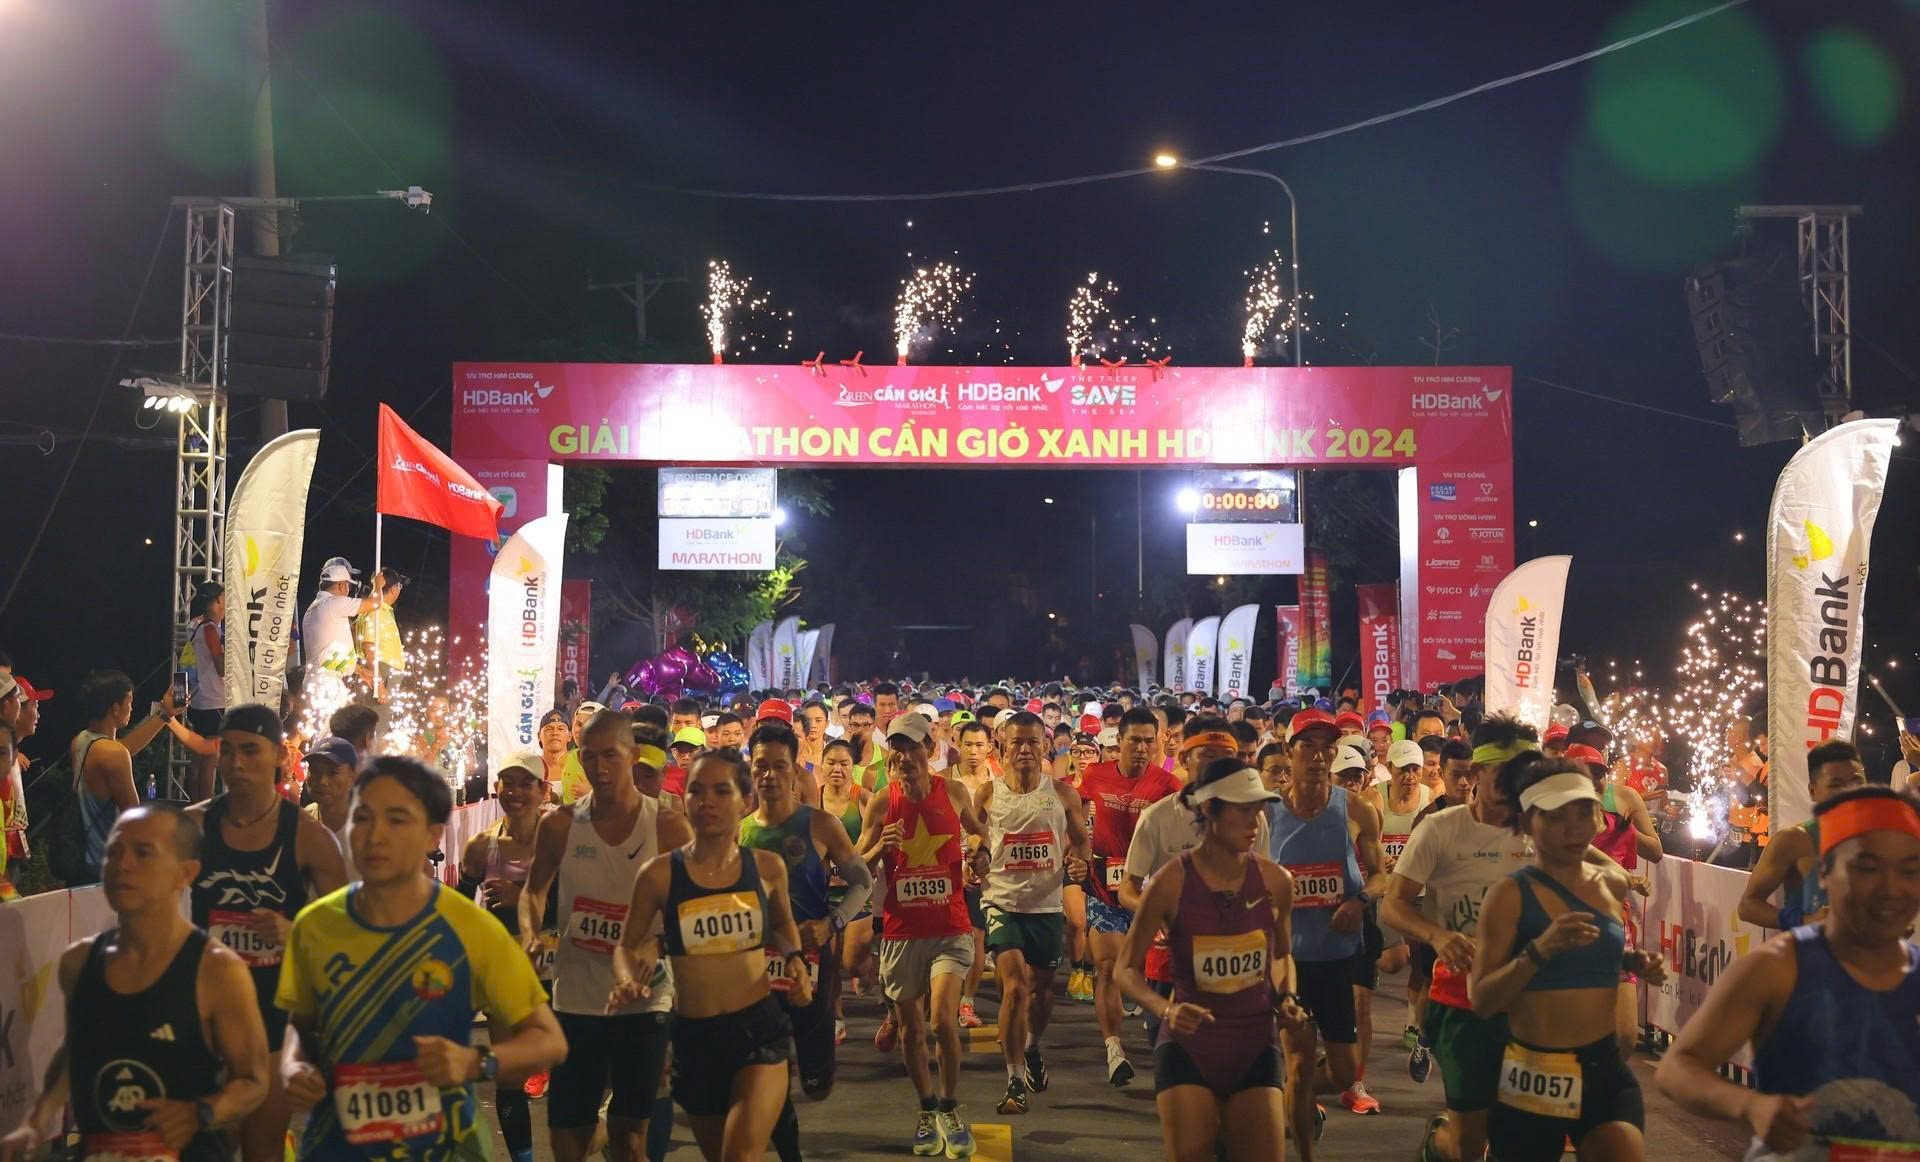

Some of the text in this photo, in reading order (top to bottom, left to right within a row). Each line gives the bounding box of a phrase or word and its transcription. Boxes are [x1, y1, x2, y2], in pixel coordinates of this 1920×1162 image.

[463, 390, 534, 405] HDBank
[958, 383, 1041, 401] HDBank
[1071, 385, 1136, 406] SAVE
[1411, 394, 1482, 409] HDBank
[640, 427, 859, 457] ATHON
[957, 421, 1030, 458] GIỜ
[1037, 429, 1145, 458] XANH
[1158, 429, 1317, 458] HDNK
[1325, 429, 1417, 458] 2024
[686, 529, 734, 540] HDBank
[1214, 535, 1263, 546] HDBank
[672, 552, 762, 565] MARATHON
[275, 575, 291, 609] nhất
[522, 575, 539, 646] HDBank
[269, 616, 282, 642] cao
[260, 648, 274, 671] ích
[1515, 616, 1537, 688] HDBank
[1805, 571, 1850, 749] HDBank
[1010, 844, 1049, 860] 41568
[903, 879, 946, 897] 41339
[694, 910, 753, 938] 40011
[222, 930, 274, 951] 4115
[1660, 919, 1732, 986] HDBank
[1202, 950, 1262, 977] 40028
[1508, 1066, 1574, 1099] 40057
[347, 1086, 426, 1120] 41081
